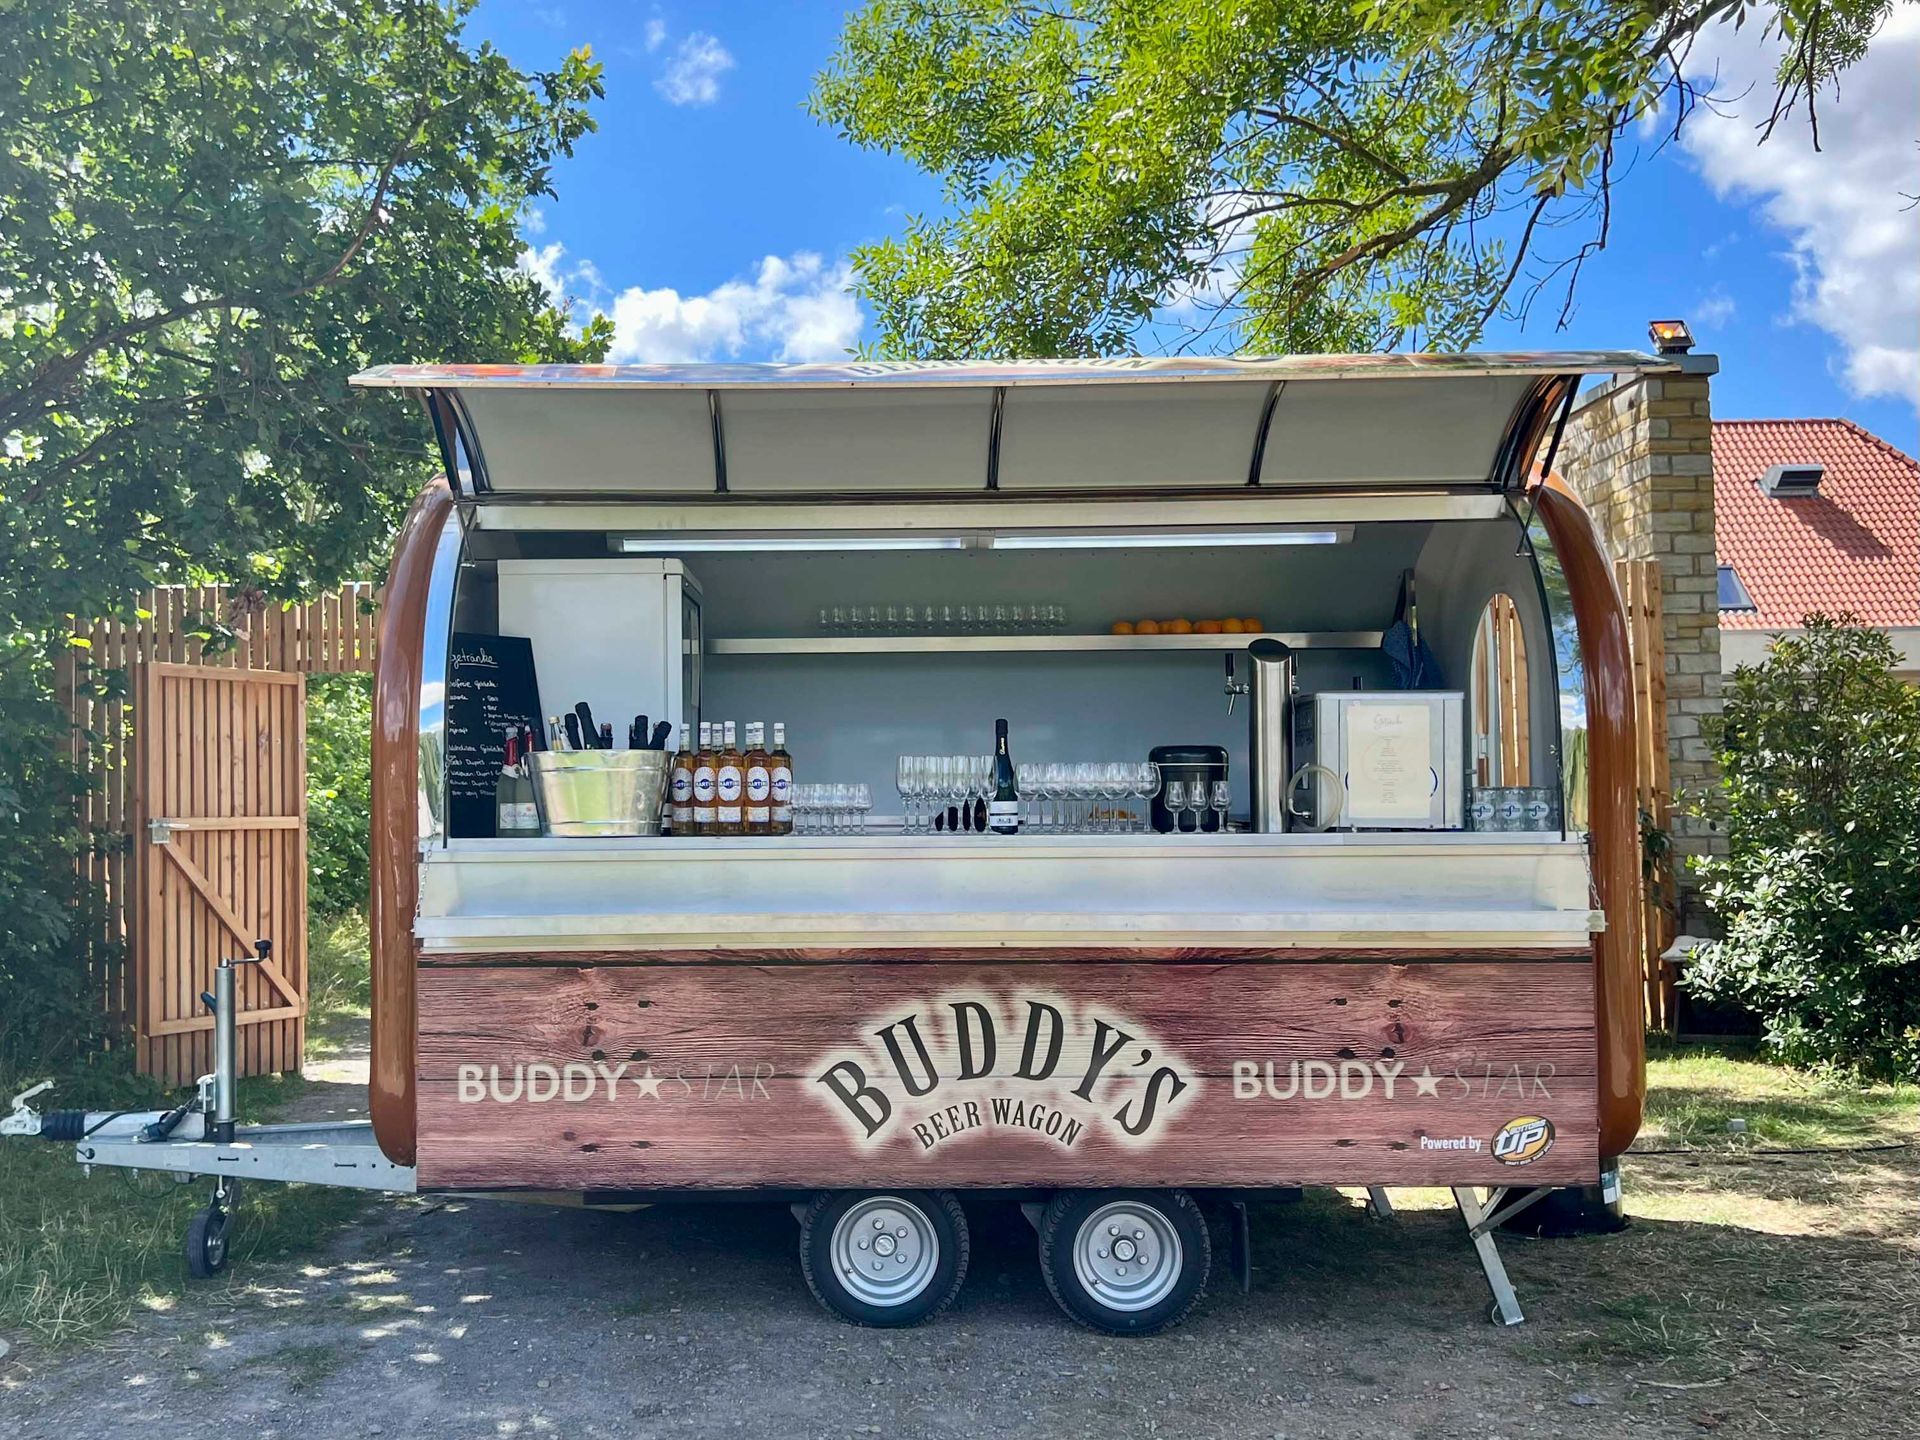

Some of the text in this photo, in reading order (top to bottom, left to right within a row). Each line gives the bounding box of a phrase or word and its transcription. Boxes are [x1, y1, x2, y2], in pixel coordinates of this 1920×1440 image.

[457, 1062, 775, 1103] BUDDY STAR
[816, 1000, 1187, 1140] BUDDY'S
[1232, 1060, 1556, 1100] BUDDY STAR
[911, 1098, 1083, 1150] BEER WAGON
[1420, 1136, 1481, 1153] Powered by
